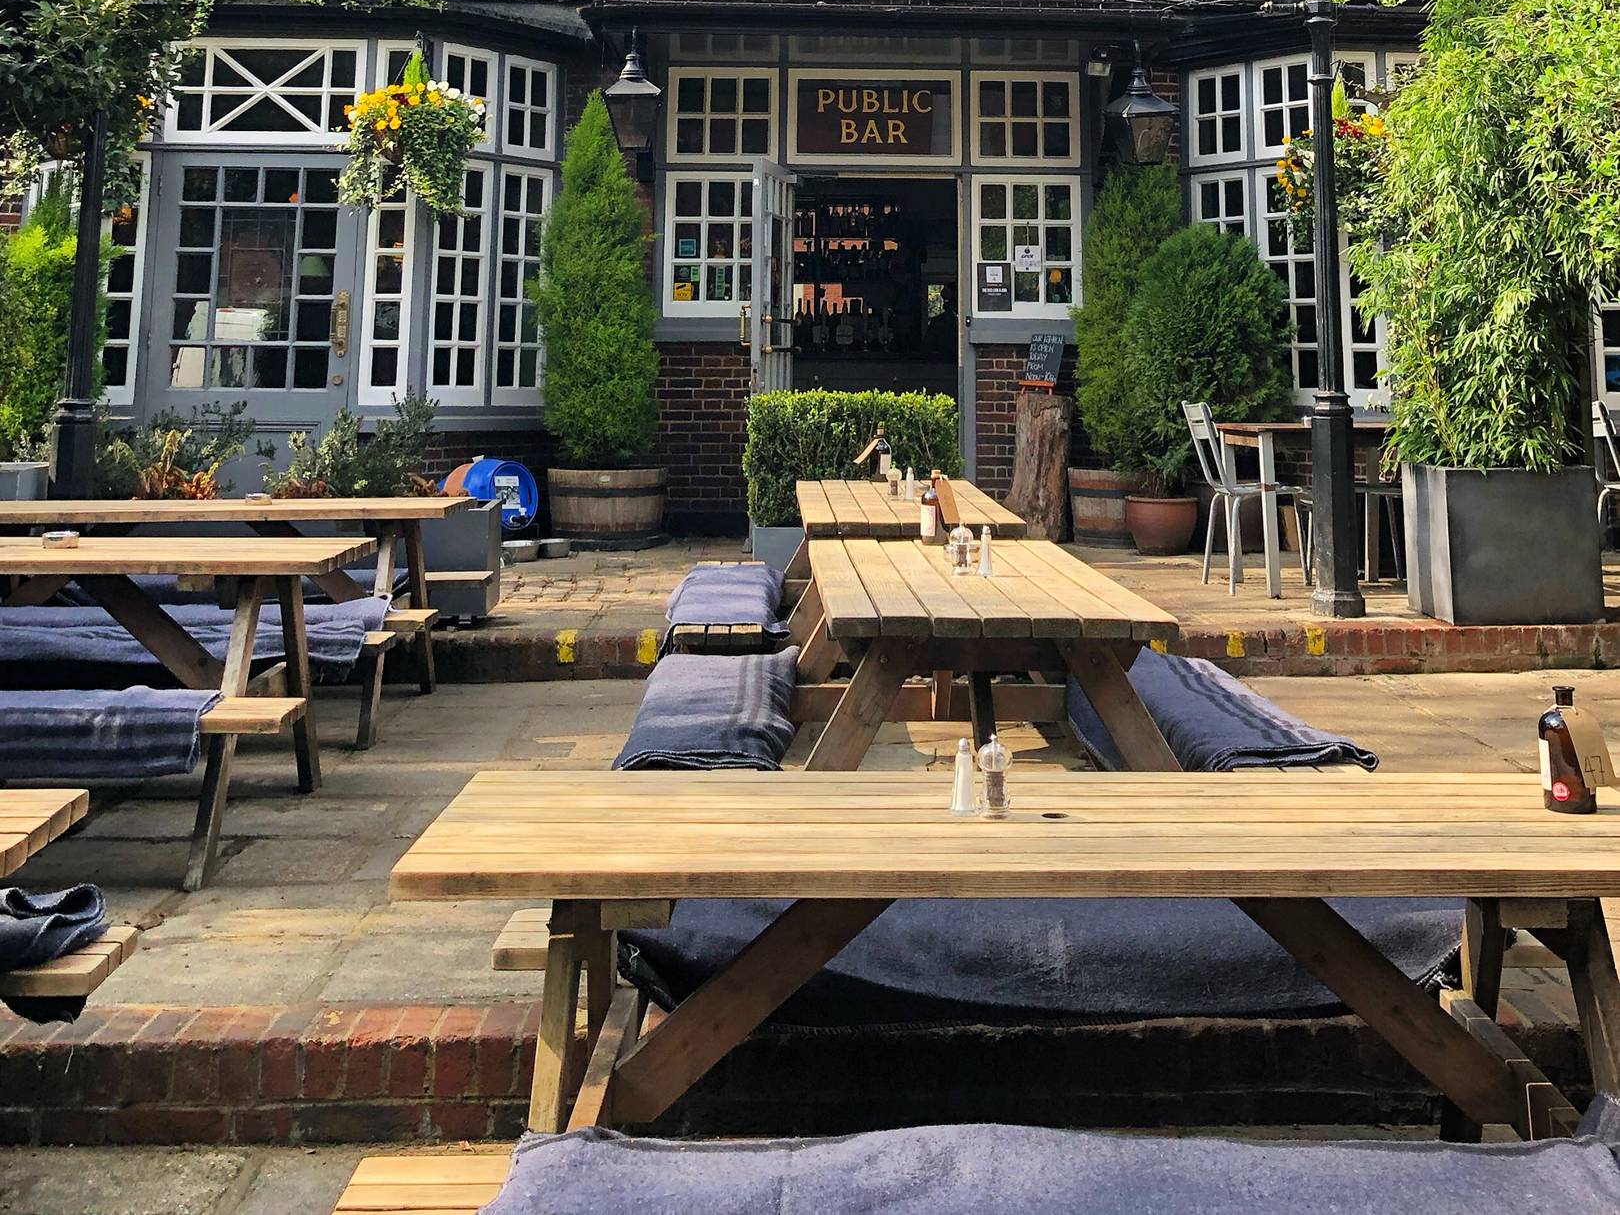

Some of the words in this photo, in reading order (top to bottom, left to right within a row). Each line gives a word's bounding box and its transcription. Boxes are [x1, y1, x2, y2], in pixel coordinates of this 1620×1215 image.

[817, 88, 933, 114] PUBLIC
[840, 119, 909, 144] BAR
[1037, 345, 1055, 353] OPEN
[1584, 755, 1606, 785] 47
